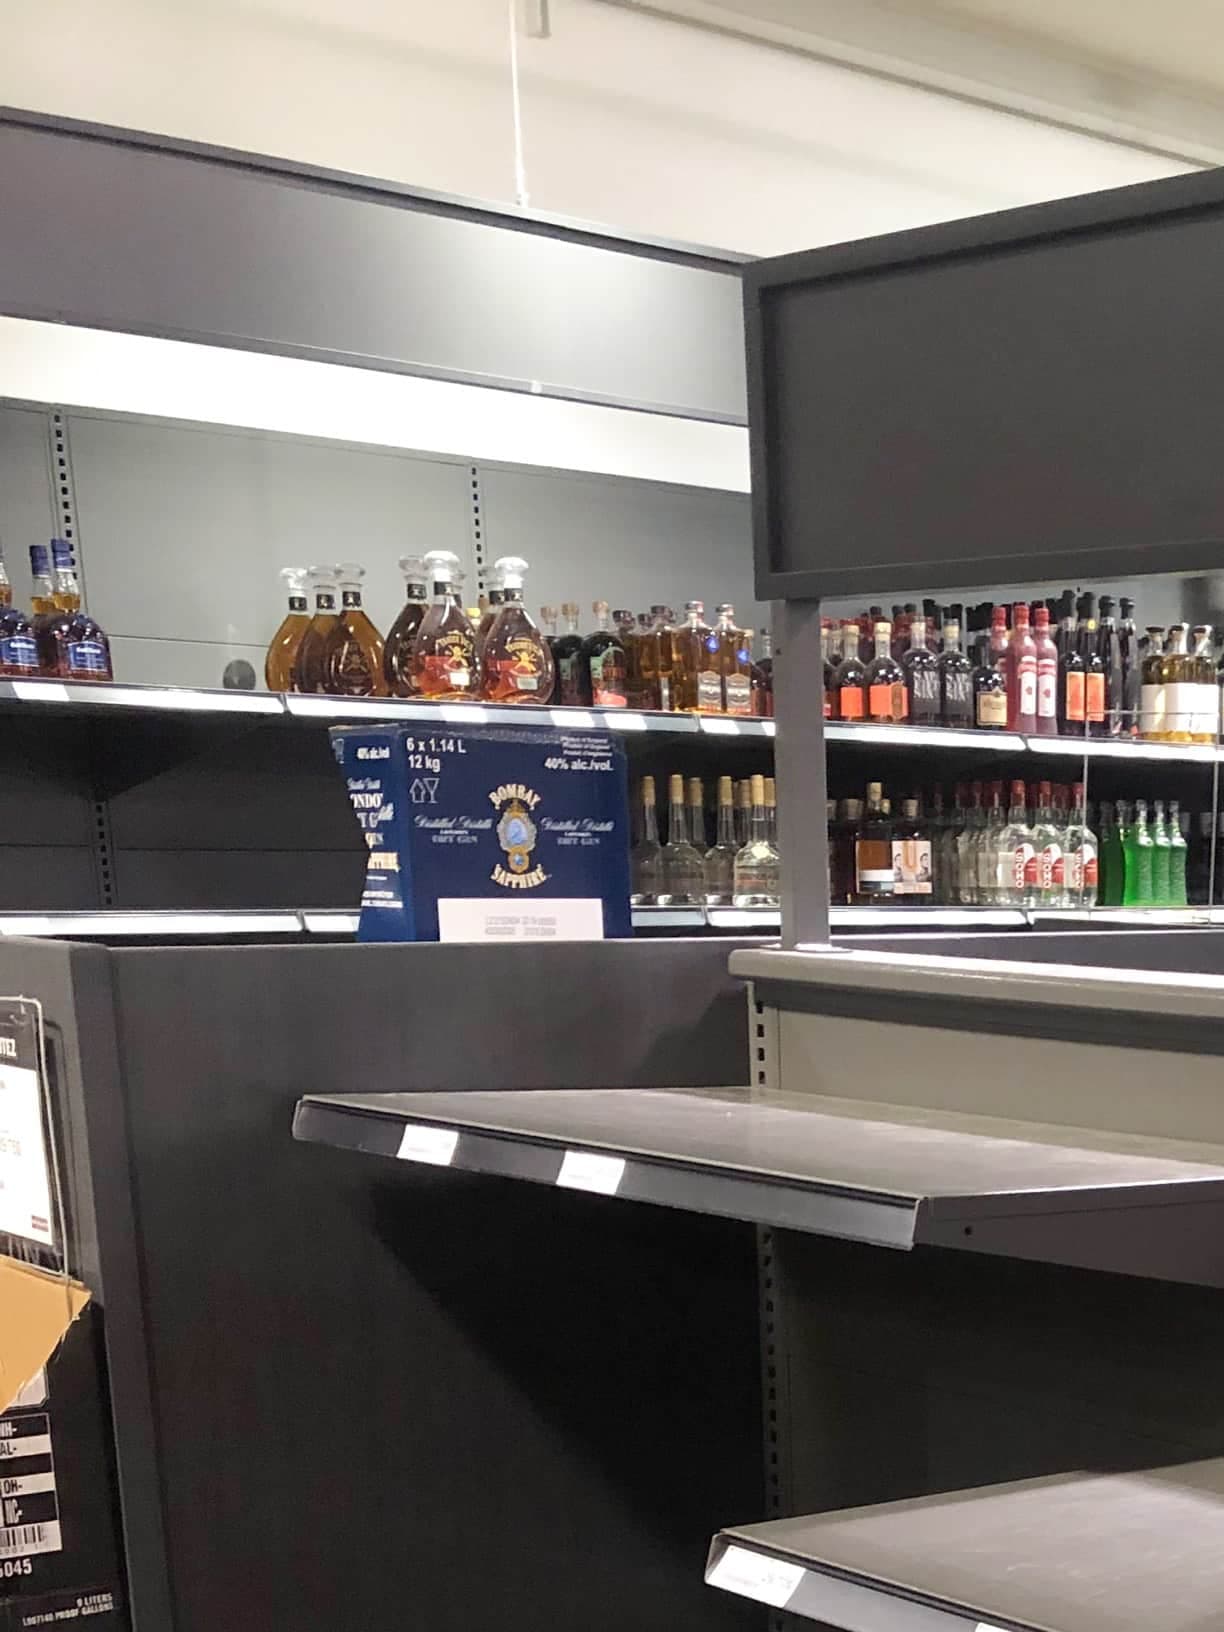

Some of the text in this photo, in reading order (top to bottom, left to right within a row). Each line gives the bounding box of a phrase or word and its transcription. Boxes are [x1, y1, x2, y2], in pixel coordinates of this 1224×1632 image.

[407, 738, 415, 751] 6
[430, 738, 455, 752] 1.14
[458, 739, 467, 753] L
[408, 754, 441, 773] 12 kg
[488, 783, 542, 811] BOMBAY
[490, 863, 548, 889] SAPPHIRE
